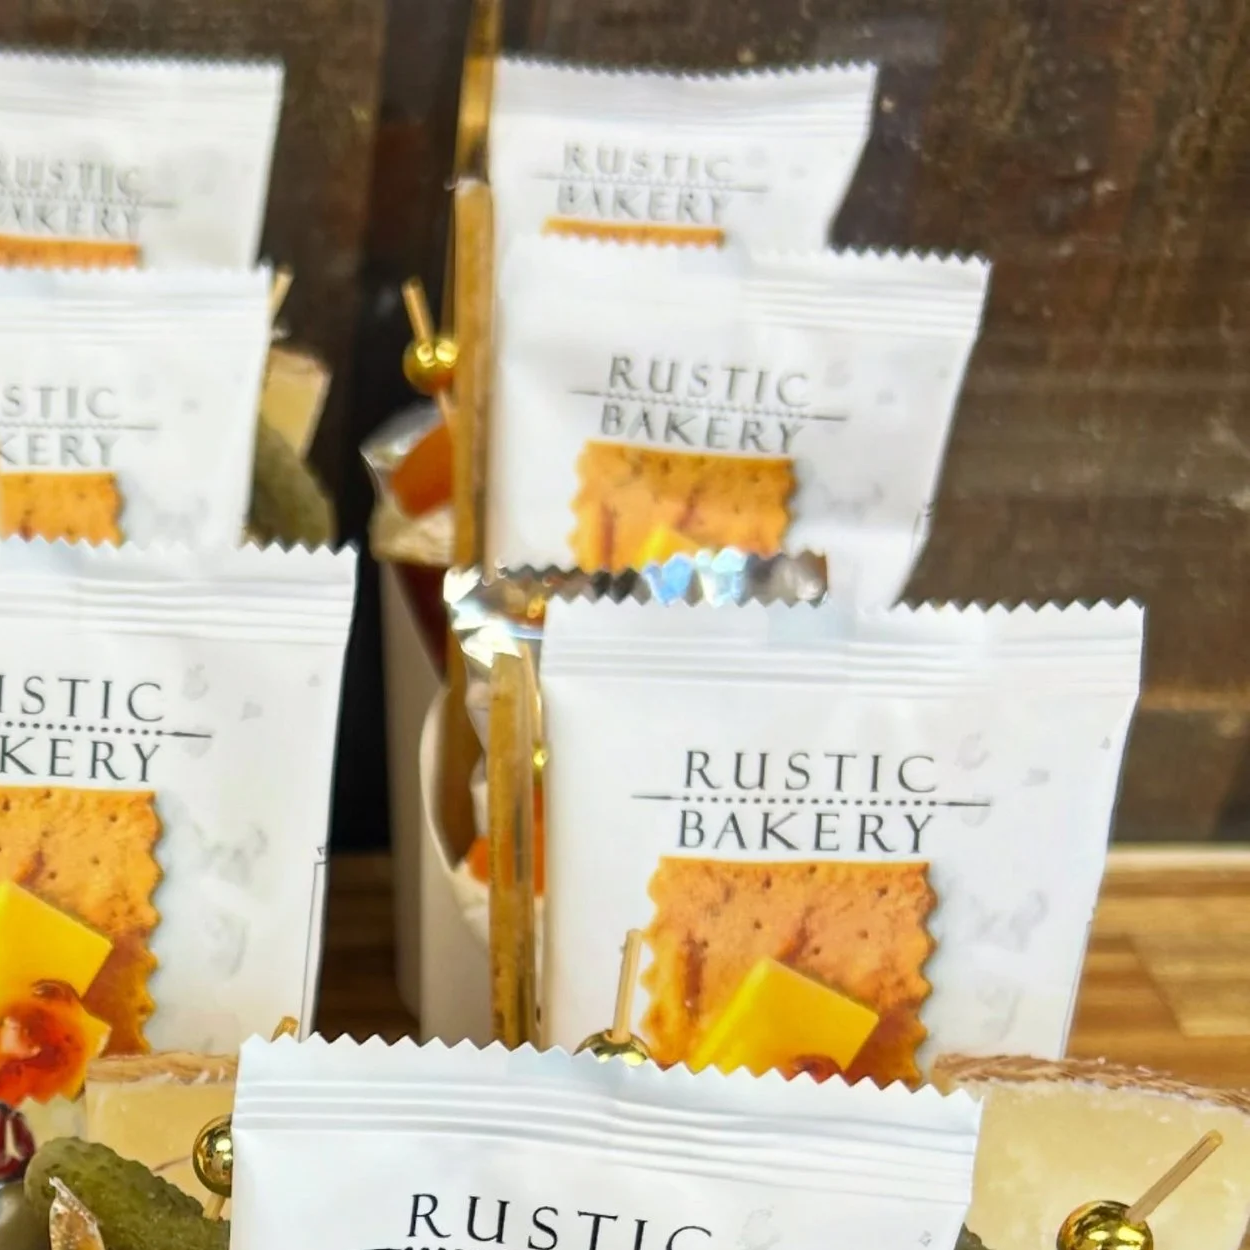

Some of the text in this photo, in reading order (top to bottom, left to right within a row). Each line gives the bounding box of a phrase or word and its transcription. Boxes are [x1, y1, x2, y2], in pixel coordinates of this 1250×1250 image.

[562, 140, 733, 184] RUSTIC
[557, 184, 733, 224] BAKERY
[608, 354, 809, 408] RUSTIC
[601, 403, 807, 453] BAKERY
[683, 750, 938, 794] RUSTIC
[678, 808, 937, 854] BAKERY
